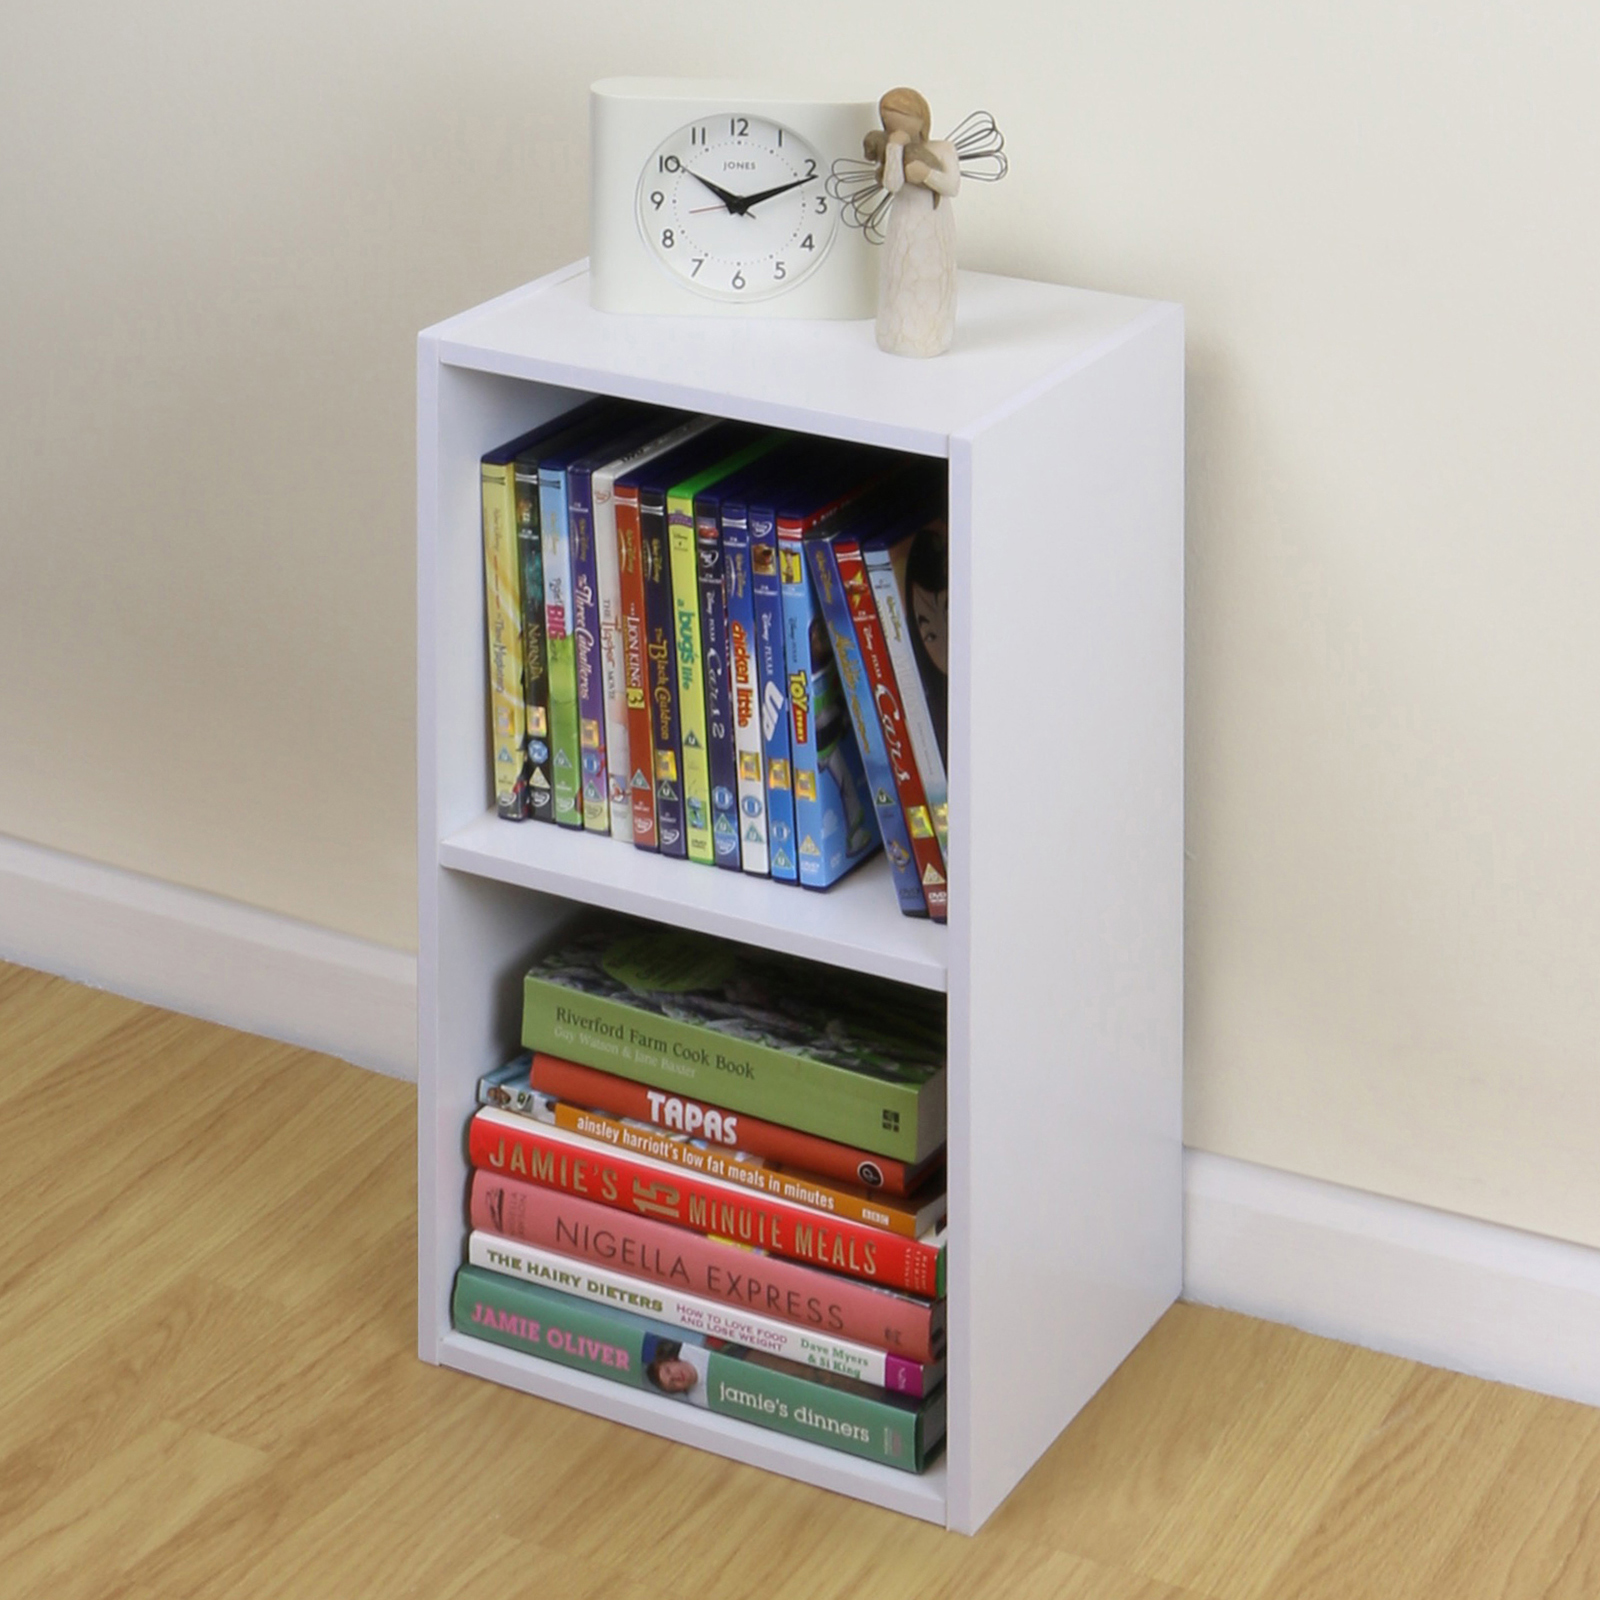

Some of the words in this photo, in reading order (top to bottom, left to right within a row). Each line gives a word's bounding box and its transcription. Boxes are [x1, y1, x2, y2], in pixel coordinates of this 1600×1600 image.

[692, 127, 706, 145] 11
[731, 117, 749, 137] 12
[778, 128, 783, 148] 1
[659, 155, 681, 173] 10
[723, 161, 756, 171] JONES
[803, 158, 817, 177] 2
[650, 191, 665, 211] 9
[815, 196, 828, 215] 3
[662, 229, 675, 248] 8
[800, 233, 815, 251] 4
[691, 258, 704, 278] 7
[732, 269, 746, 290] 6
[773, 261, 786, 280] 5
[577, 573, 587, 587] The
[547, 603, 567, 641] BIG
[575, 585, 593, 625] Three
[602, 599, 611, 619] THE
[601, 615, 621, 668] Tigger
[627, 615, 641, 650] LION
[677, 610, 698, 665] bug's
[761, 611, 773, 641] Disney
[528, 623, 543, 681] NARNIA
[576, 627, 595, 700] Caballeros
[648, 640, 668, 685] Black
[730, 620, 749, 685] chicken
[765, 645, 774, 675] PIXAR
[863, 624, 874, 651] Disney
[871, 653, 882, 679] PIXAR
[608, 671, 617, 700] MOVIE
[630, 652, 642, 687] KING
[681, 666, 694, 690] life
[706, 648, 722, 718] Cars
[628, 690, 643, 705] 3
[736, 687, 754, 728] little
[789, 670, 808, 713] TOY
[653, 685, 671, 741] Cauldron
[795, 709, 805, 742] STORY
[712, 723, 725, 739] 2
[875, 683, 911, 785] Cars
[554, 1025, 575, 1044] Guy
[579, 1032, 620, 1055] Watson
[555, 1006, 624, 1040] Riverford
[629, 1028, 668, 1053] Farm
[672, 1042, 710, 1067] Cook
[716, 1054, 756, 1080] Book
[647, 1090, 738, 1145] TAPAS
[577, 1115, 620, 1143] ainsley
[623, 1127, 679, 1160] harriott's
[682, 1147, 705, 1168] low
[707, 1156, 724, 1176] fat
[728, 1162, 765, 1188] meals
[768, 1173, 780, 1193] in
[784, 1178, 835, 1210] minutes
[488, 1137, 618, 1201] JAMIE'S
[632, 1176, 681, 1219] 15
[688, 1192, 784, 1248] MINUTE
[795, 1221, 877, 1275] MEALS
[486, 1249, 523, 1272] THE
[527, 1261, 582, 1288] HAIRY
[586, 1279, 664, 1313] DIETERS
[555, 1216, 691, 1285] NIGELLA
[707, 1264, 844, 1331] EXPRESS
[471, 1302, 541, 1343] JAMIE
[546, 1327, 631, 1372] OLIVER
[676, 1303, 703, 1320] HOW
[705, 1312, 721, 1324] TO
[724, 1317, 753, 1335] LOVE
[757, 1327, 788, 1345] FOOD
[680, 1315, 704, 1328] AND
[706, 1322, 736, 1339] LOSE
[738, 1330, 783, 1352] WEIGHT
[800, 1337, 830, 1356] Dave
[832, 1347, 870, 1368] Myers
[807, 1353, 818, 1365] &
[819, 1356, 831, 1369] Si
[833, 1360, 862, 1380] King
[717, 1381, 789, 1418] jamie's
[794, 1405, 870, 1444] dinners
